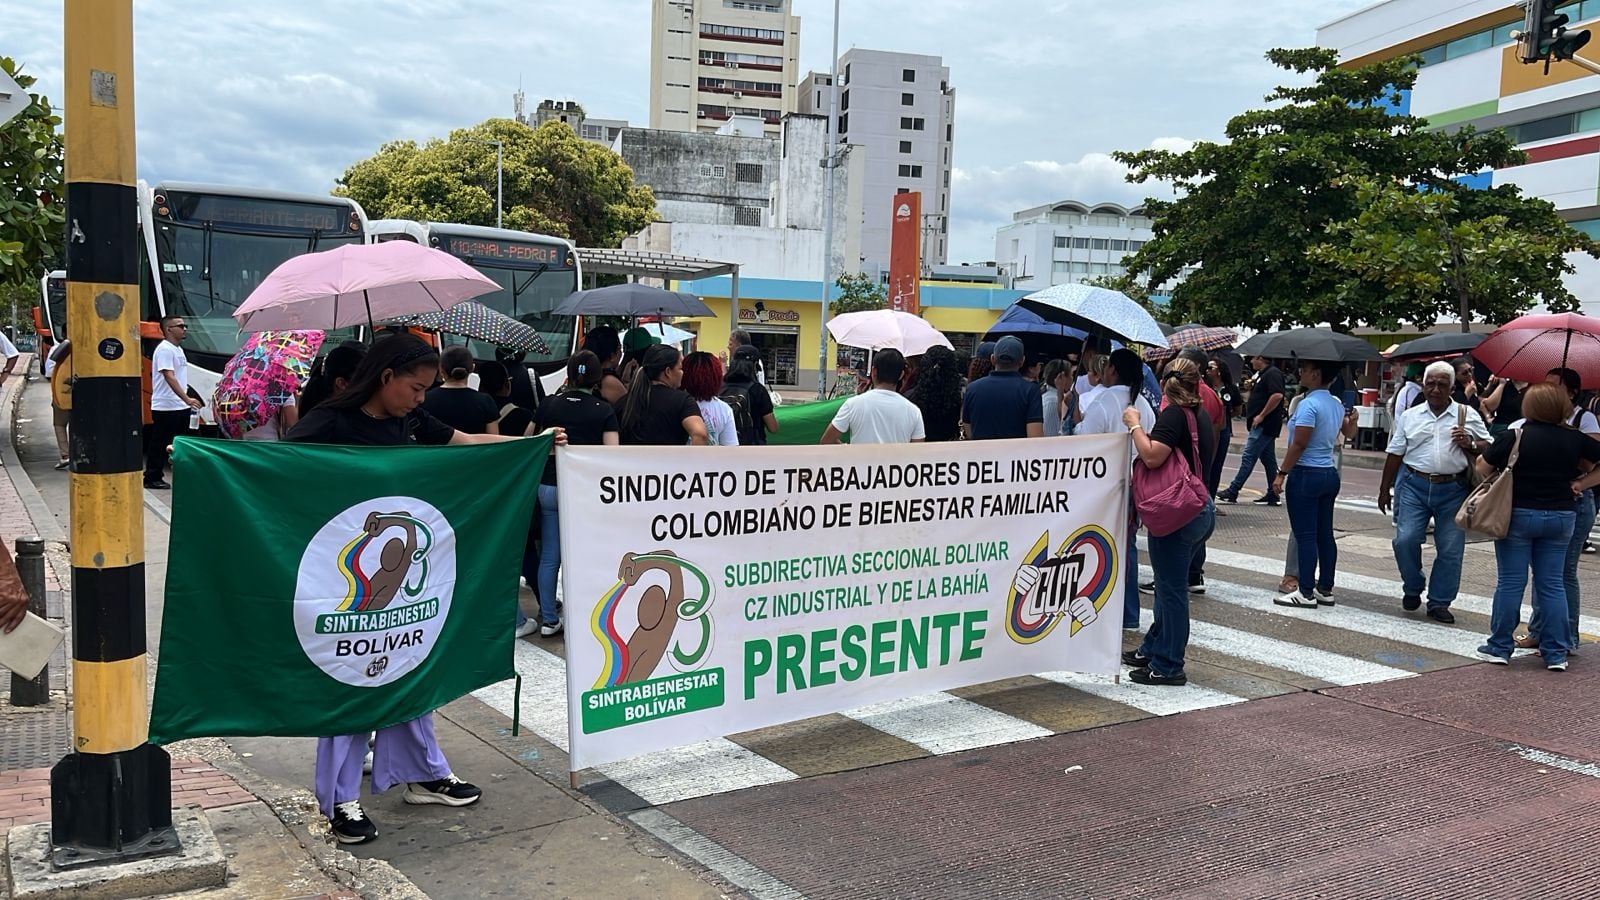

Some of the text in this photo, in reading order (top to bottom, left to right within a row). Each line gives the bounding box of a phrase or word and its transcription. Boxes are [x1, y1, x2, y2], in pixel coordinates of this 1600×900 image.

[599, 456, 1107, 504] SINDICATO DE TRABAJADORES DEL INSTITUTO
[651, 491, 1070, 541] COLOMBIANO DE BIENESTAR FAMILIAR
[724, 540, 1009, 587] SUBDIRECTIVA SECCIONAL BOLIVAR
[323, 602, 437, 633] SINTRABIENESTAR
[744, 569, 989, 621] CZ INDUSTRIAL Y DE LA BAHÍA
[336, 629, 423, 657] BOLÍVAR
[744, 610, 988, 700] PRESENTE
[588, 672, 719, 709] SINTRABIENESTAR
[624, 696, 687, 721] BOLÍVAR
